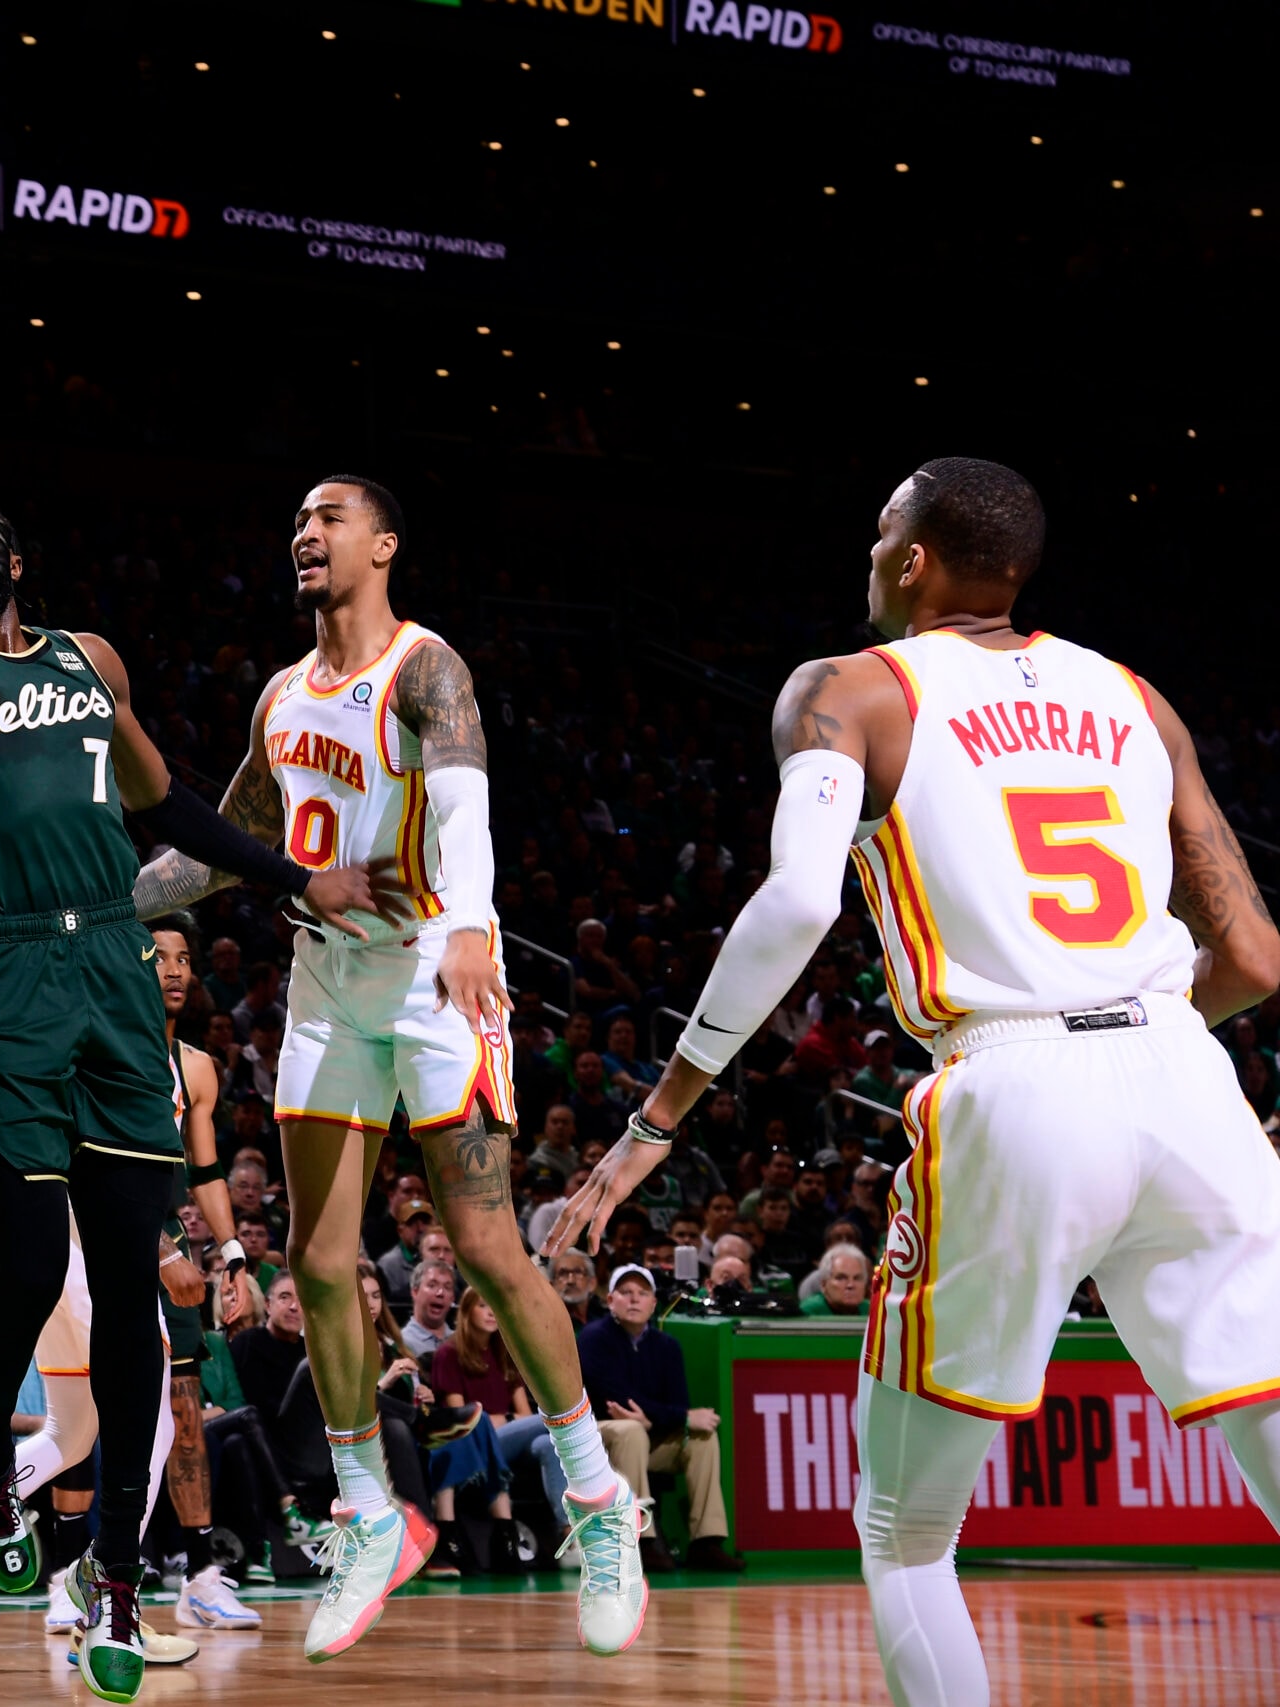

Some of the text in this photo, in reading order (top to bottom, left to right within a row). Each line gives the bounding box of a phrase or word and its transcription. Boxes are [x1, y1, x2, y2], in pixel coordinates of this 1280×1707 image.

[873, 23, 1131, 75] OFFICIAL CYBERSECURITY PARTNER
[949, 56, 1057, 86] OF TD GARDEN
[222, 206, 507, 259] OFFICIAL CYBERSECURITY PARTNER
[308, 240, 426, 271] OF TD GARDEN
[948, 701, 1132, 767] MURRAY
[82, 737, 109, 803] 7
[266, 729, 366, 796] TLANTA
[1001, 785, 1148, 949] 5
[65, 914, 77, 930] 6
[753, 1394, 859, 1511] THI
[4, 1550, 22, 1573] 6
